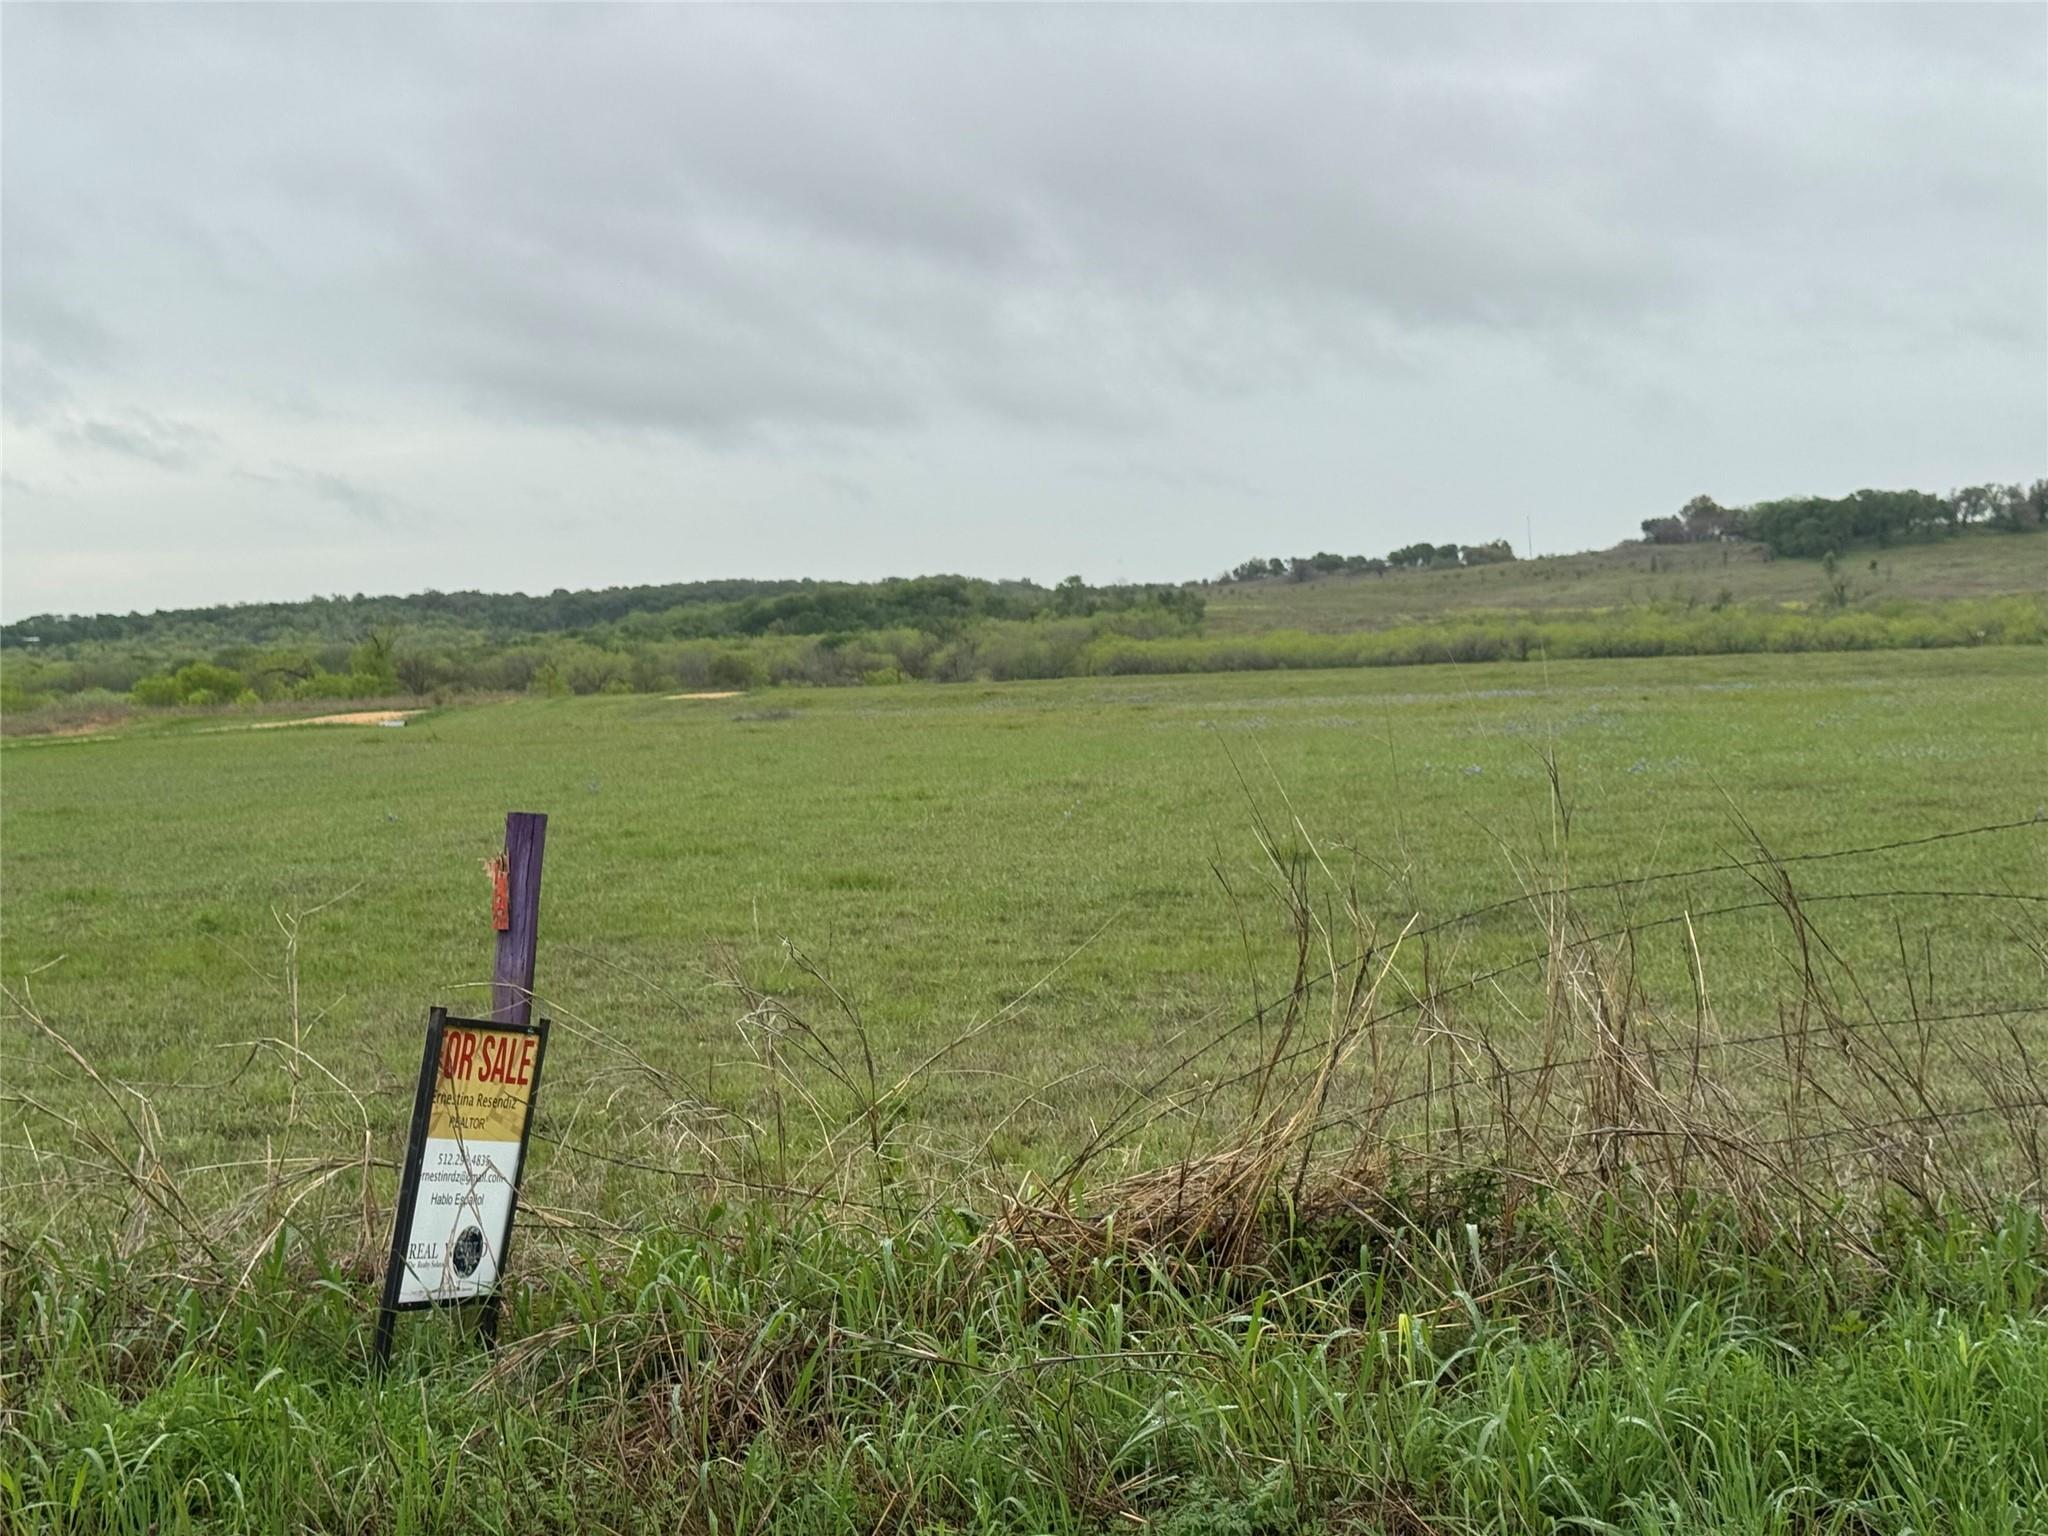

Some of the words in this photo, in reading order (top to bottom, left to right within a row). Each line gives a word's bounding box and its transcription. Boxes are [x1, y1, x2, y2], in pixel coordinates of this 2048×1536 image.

[441, 1029, 476, 1081] OR
[478, 1034, 535, 1086] SALE
[432, 1089, 474, 1107] Ernestina
[476, 1092, 517, 1110] Resendiz
[430, 1192, 454, 1206] Hablo
[409, 1242, 439, 1260] REAL
